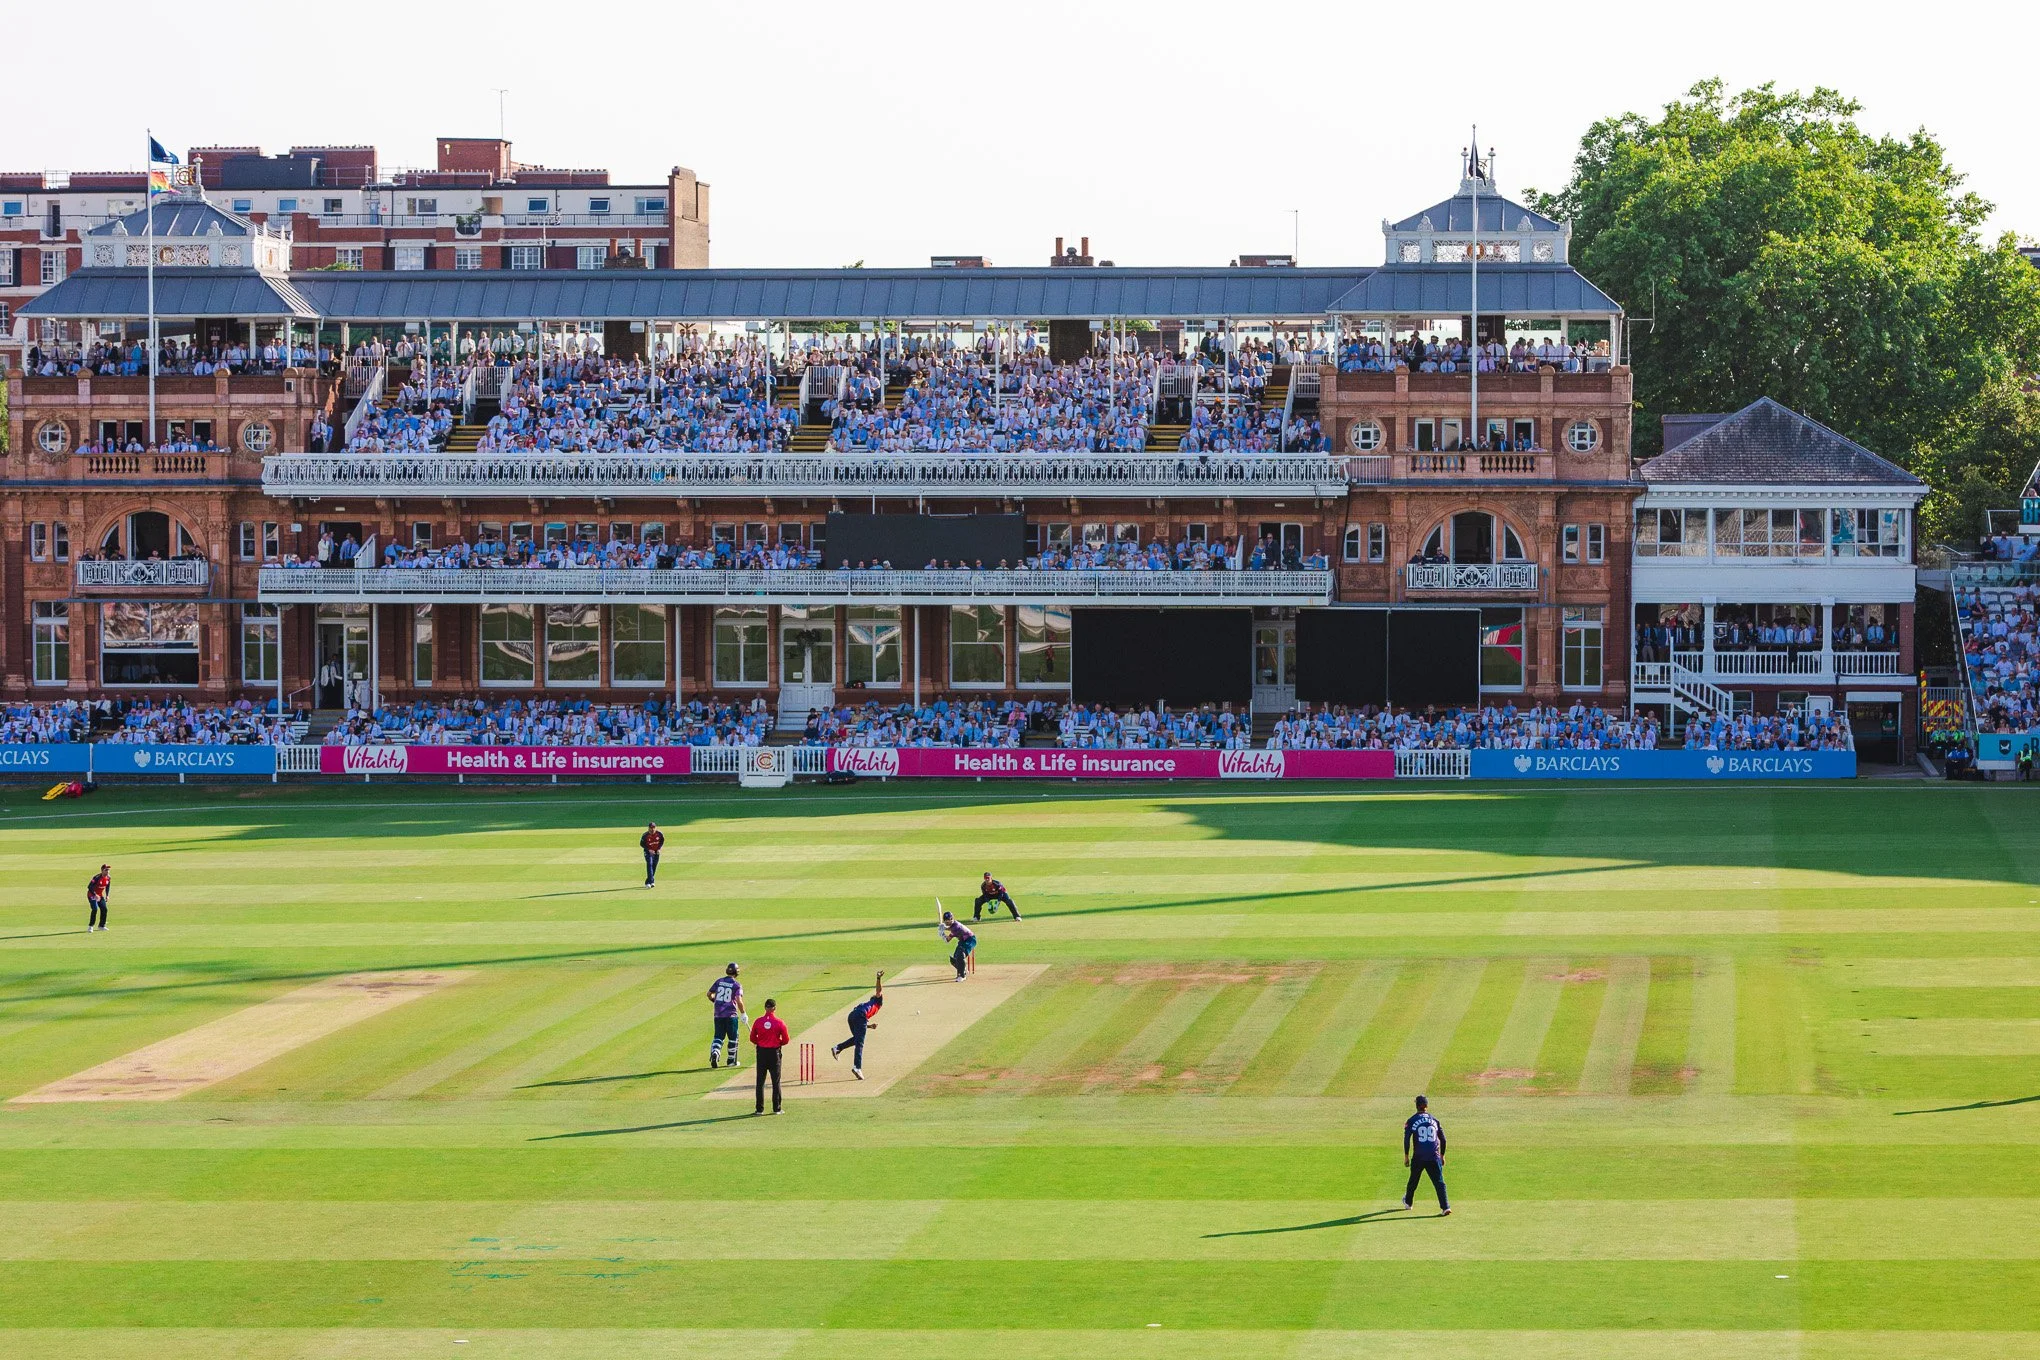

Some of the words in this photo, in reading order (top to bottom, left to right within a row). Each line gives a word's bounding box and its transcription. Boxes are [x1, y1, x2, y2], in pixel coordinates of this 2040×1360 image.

[155, 751, 234, 766] BARCLAYS
[347, 746, 405, 773] Vitality
[447, 751, 508, 768] Health
[513, 753, 528, 768] &
[532, 751, 567, 768] Life
[572, 752, 664, 769] insurance
[837, 748, 896, 776] Vitality
[954, 754, 1018, 771] Health
[1022, 755, 1036, 771] &
[1041, 754, 1077, 771] Life
[1082, 755, 1176, 772] insurance
[1222, 750, 1281, 778] Vitality
[1536, 757, 1620, 771] BARCLAYS
[1729, 758, 1812, 773] BARCLAYS
[716, 987, 732, 1003] 28
[1418, 1126, 1437, 1142] 99
